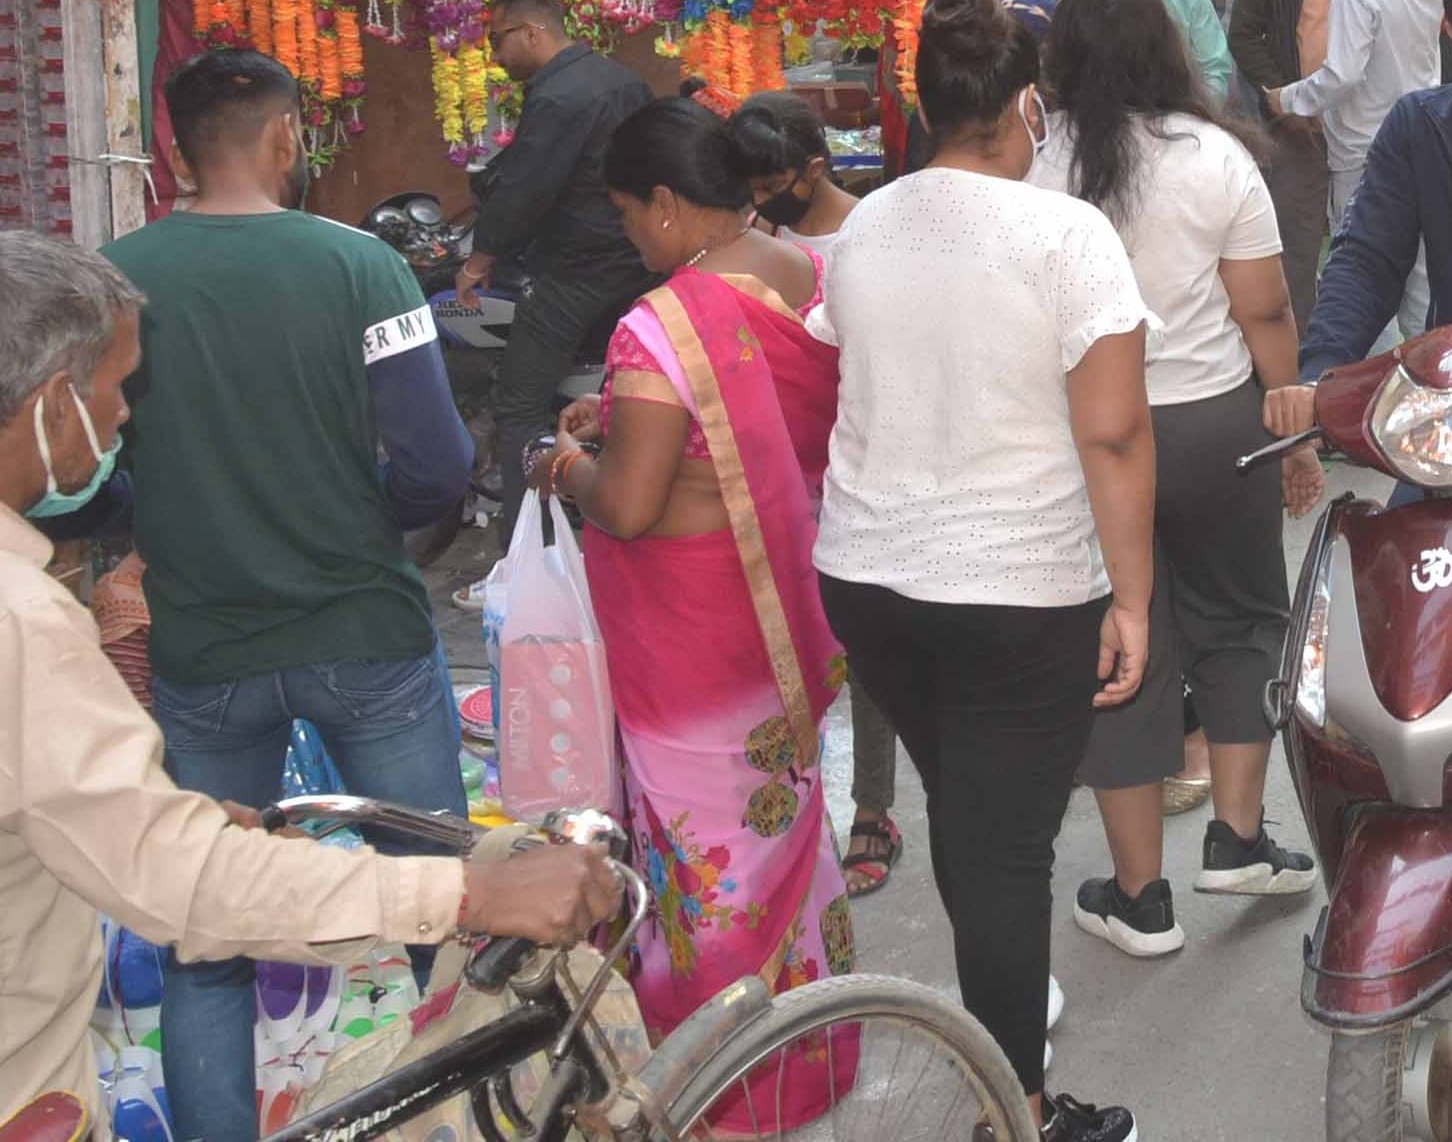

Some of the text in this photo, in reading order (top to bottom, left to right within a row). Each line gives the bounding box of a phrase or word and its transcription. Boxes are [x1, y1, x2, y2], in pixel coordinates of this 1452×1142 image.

[396, 311, 426, 342] MY
[436, 309, 485, 318] HONDA
[508, 687, 531, 769] MILTON
